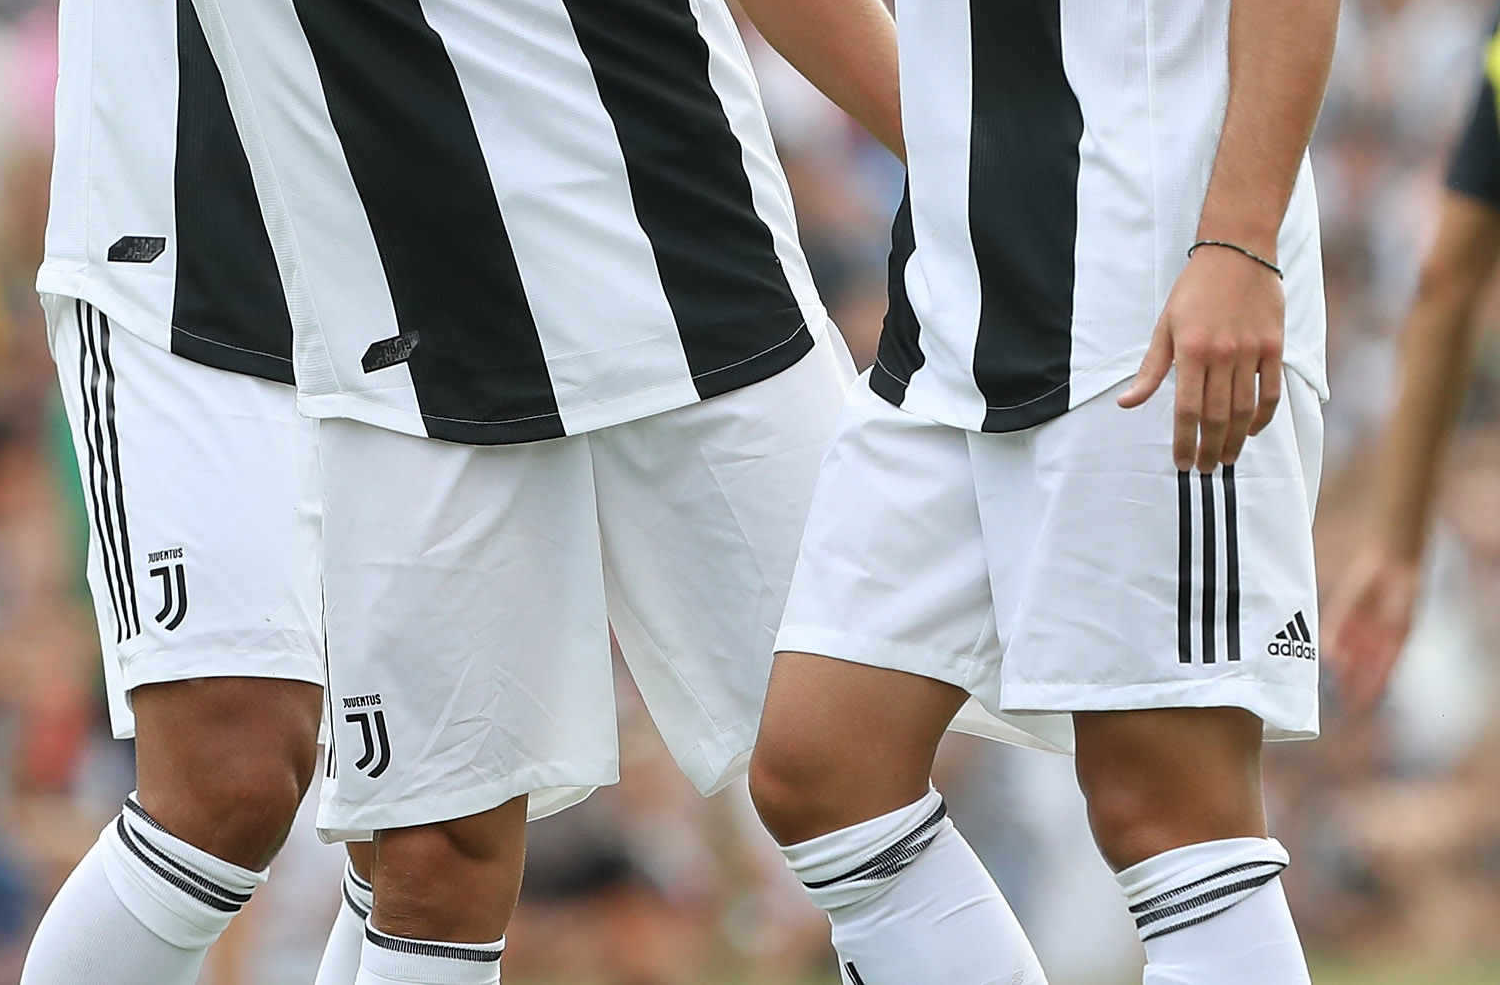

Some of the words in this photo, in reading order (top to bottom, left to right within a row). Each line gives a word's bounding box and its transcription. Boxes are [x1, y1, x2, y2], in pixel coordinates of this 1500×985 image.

[147, 547, 183, 563] JUVENTUS
[1267, 640, 1316, 661] adidas
[342, 694, 382, 708] JUVENTUS
